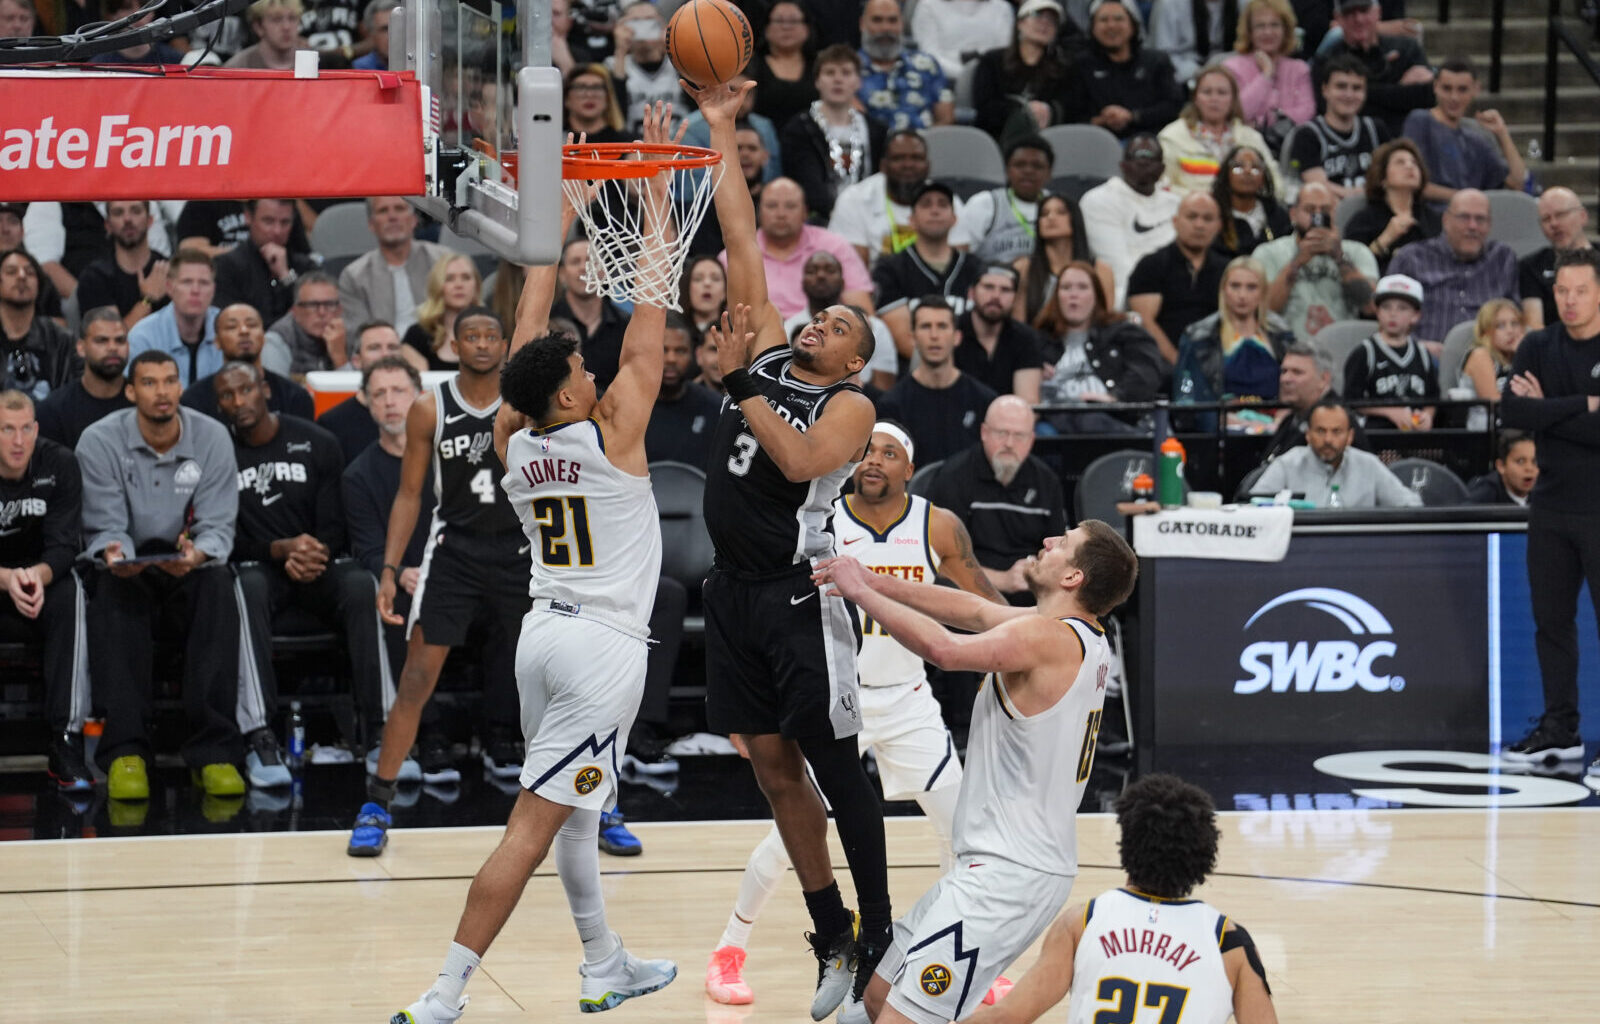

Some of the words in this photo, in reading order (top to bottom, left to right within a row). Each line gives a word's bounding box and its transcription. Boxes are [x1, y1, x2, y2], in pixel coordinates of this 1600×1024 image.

[521, 459, 581, 488] JONES
[728, 432, 759, 477] 3
[470, 469, 495, 503] 4
[531, 496, 595, 567] 21
[894, 537, 919, 545] ibotta
[1158, 521, 1257, 538] GATORADE
[1233, 640, 1397, 694] SWBC
[1076, 708, 1103, 783] 15
[1099, 928, 1201, 971] MURRAY
[1094, 975, 1190, 1024] 27
